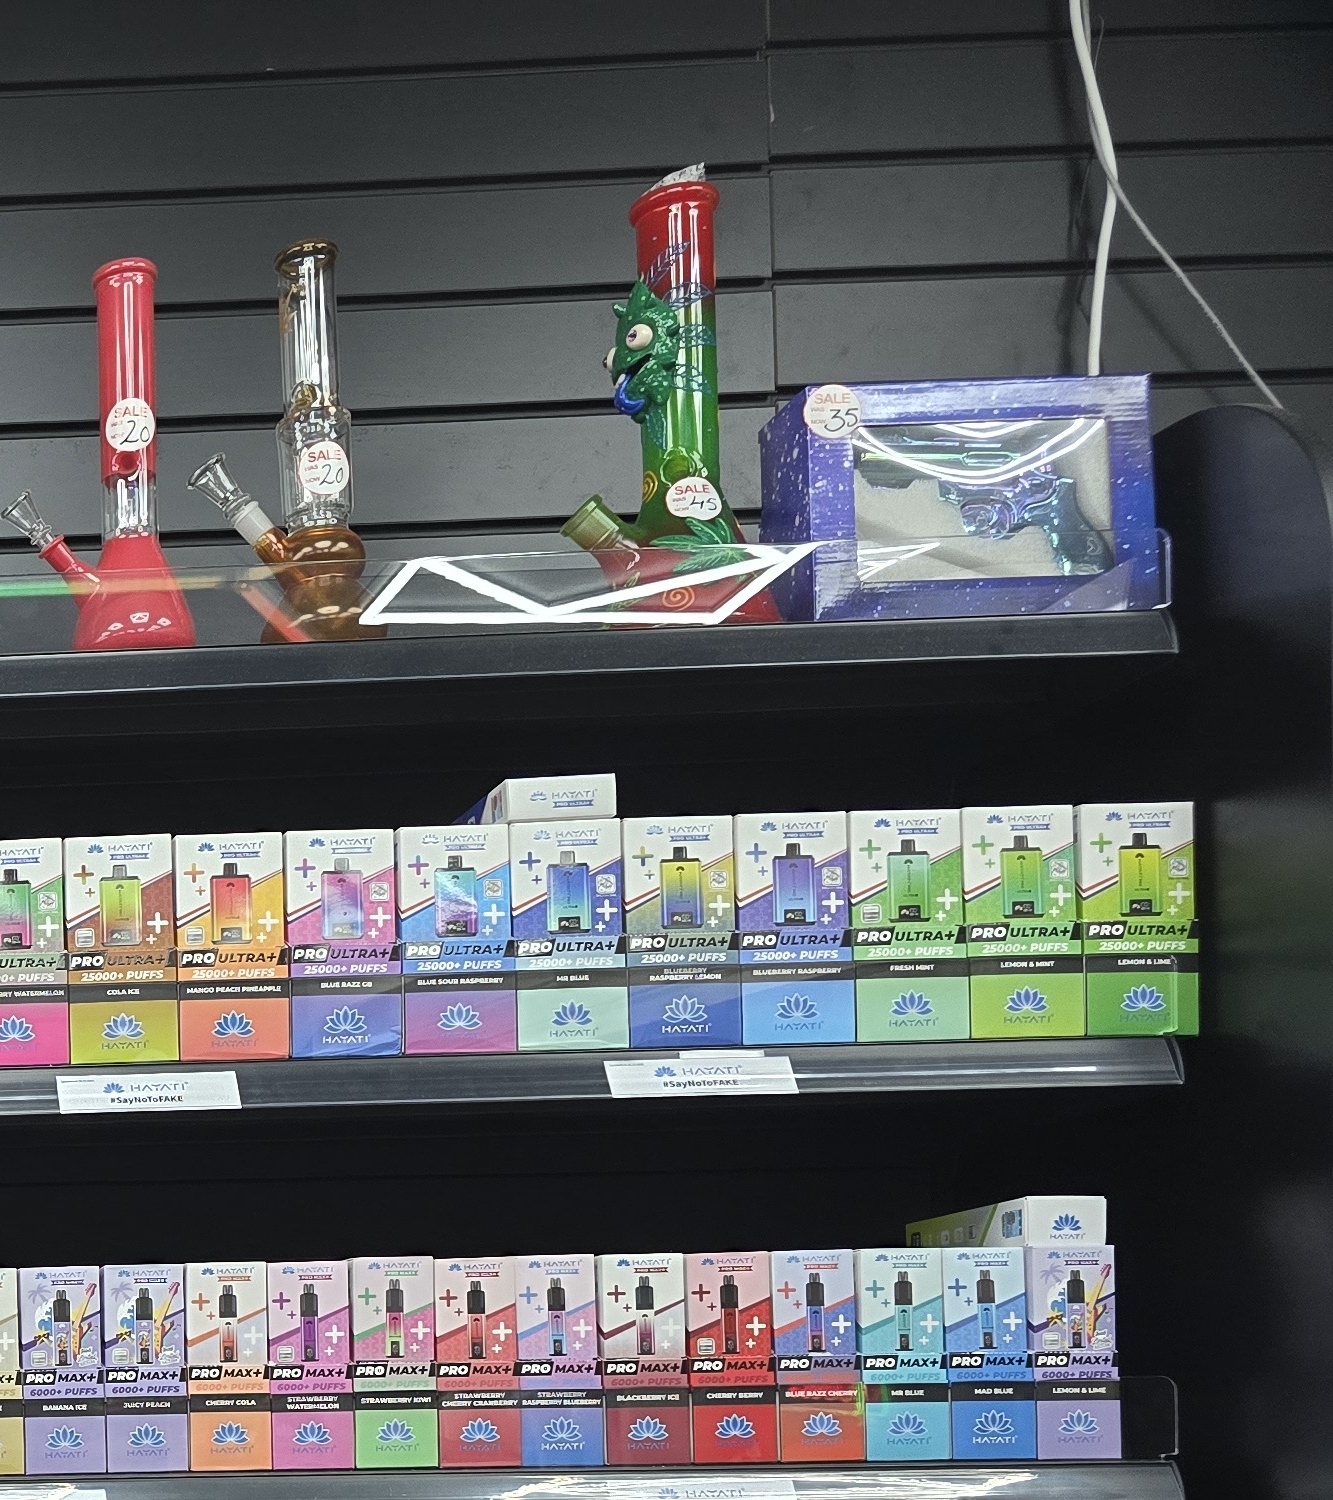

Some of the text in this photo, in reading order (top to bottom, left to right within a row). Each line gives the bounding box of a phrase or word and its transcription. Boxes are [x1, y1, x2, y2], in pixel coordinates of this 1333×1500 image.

[814, 393, 850, 404] SALE
[115, 407, 148, 418] SALE
[824, 408, 859, 431] 35
[120, 420, 150, 445] 20
[307, 449, 342, 462] SALE
[319, 464, 343, 485] 20
[675, 484, 710, 495] SALE
[689, 496, 717, 511] 45
[857, 927, 955, 943] PRO ULTRA+
[868, 945, 953, 956] 25000+ PUFFS
[915, 963, 934, 971] MINT
[993, 1387, 1013, 1395] BLUE
